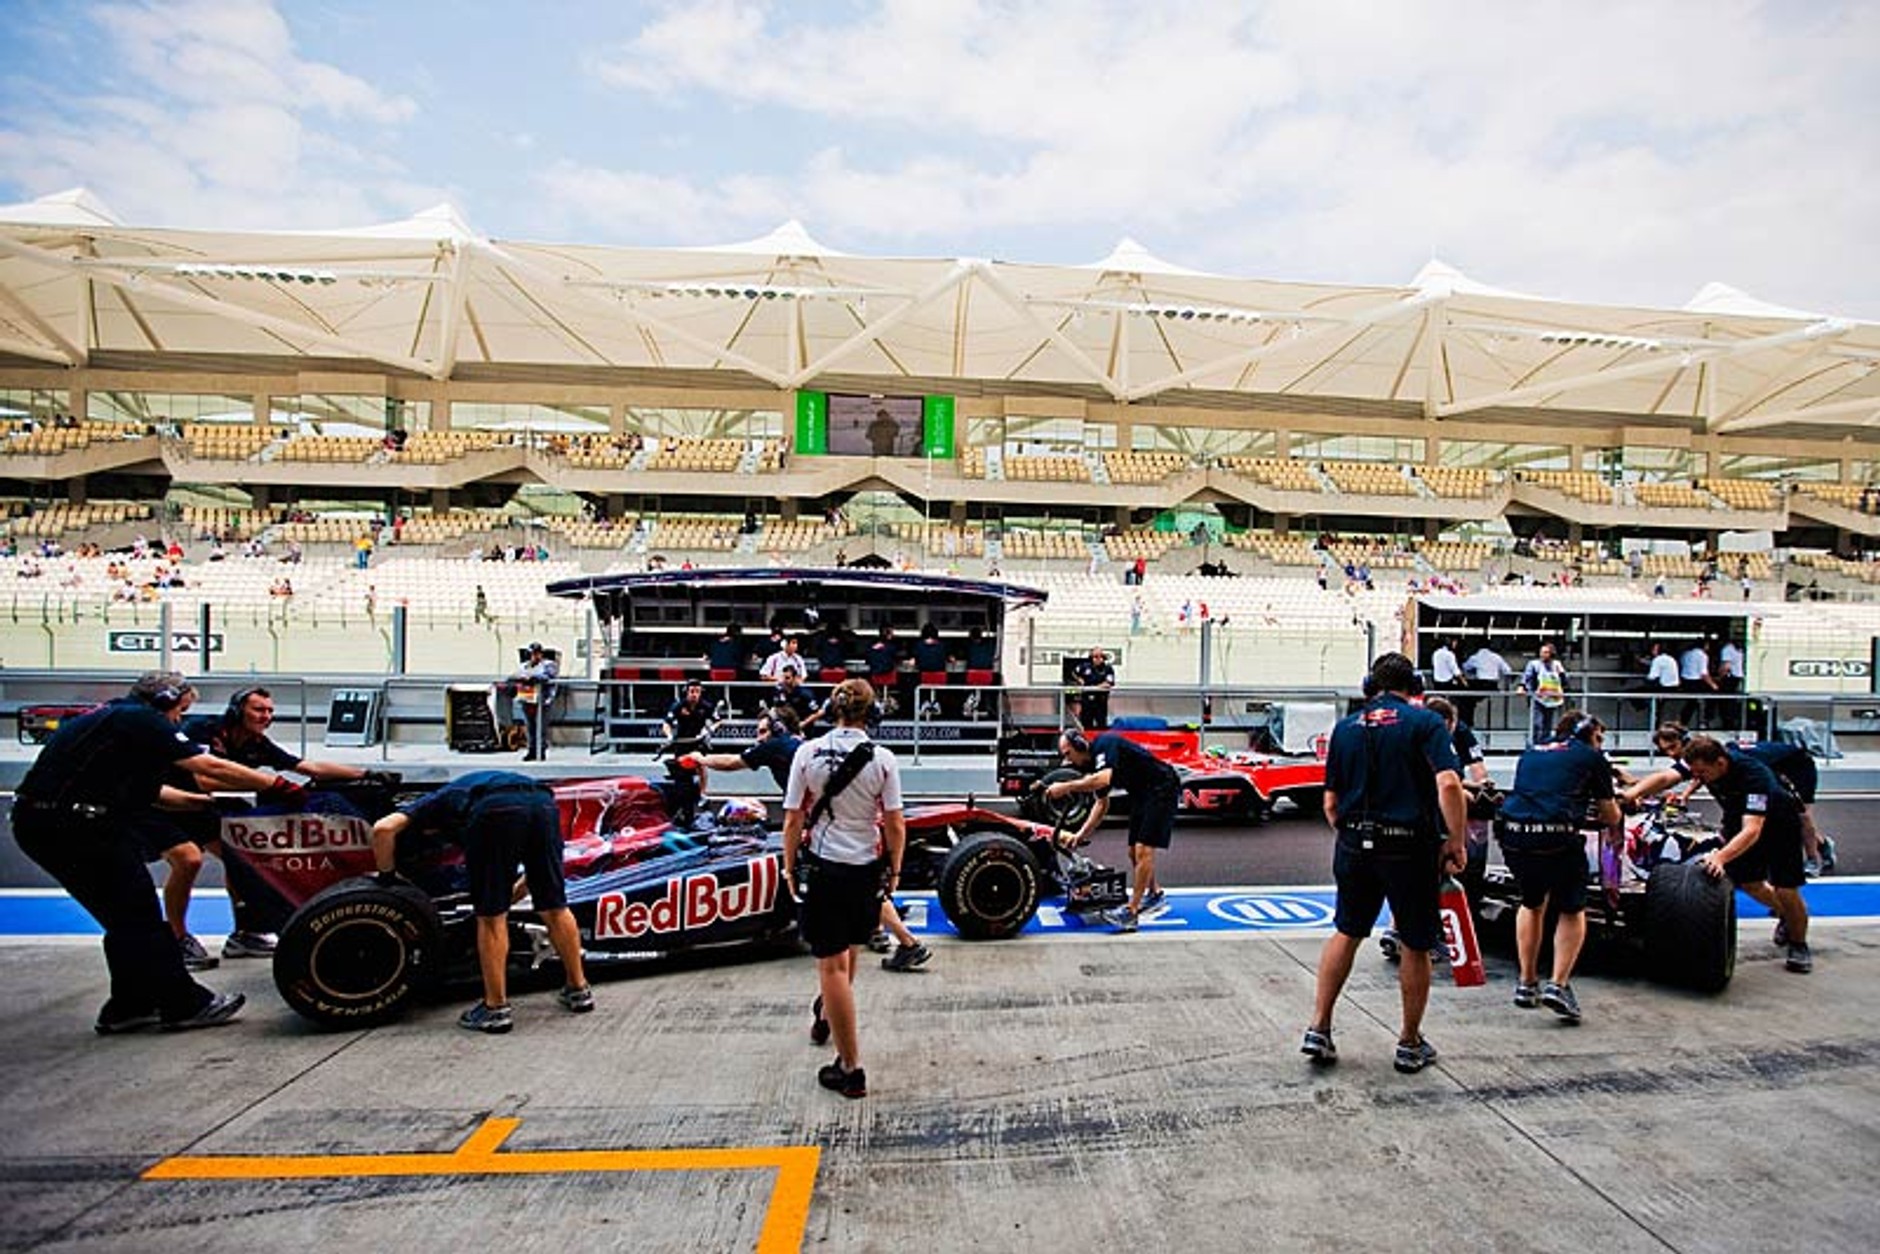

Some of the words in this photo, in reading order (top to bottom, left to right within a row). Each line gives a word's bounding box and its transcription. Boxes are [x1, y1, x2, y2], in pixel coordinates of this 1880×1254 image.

[1792, 661, 1867, 676] ETIHAD
[1178, 788, 1241, 809] NET
[228, 819, 295, 849] Red
[301, 818, 368, 848] Bull
[595, 877, 681, 940] Red
[684, 854, 779, 930] Bull
